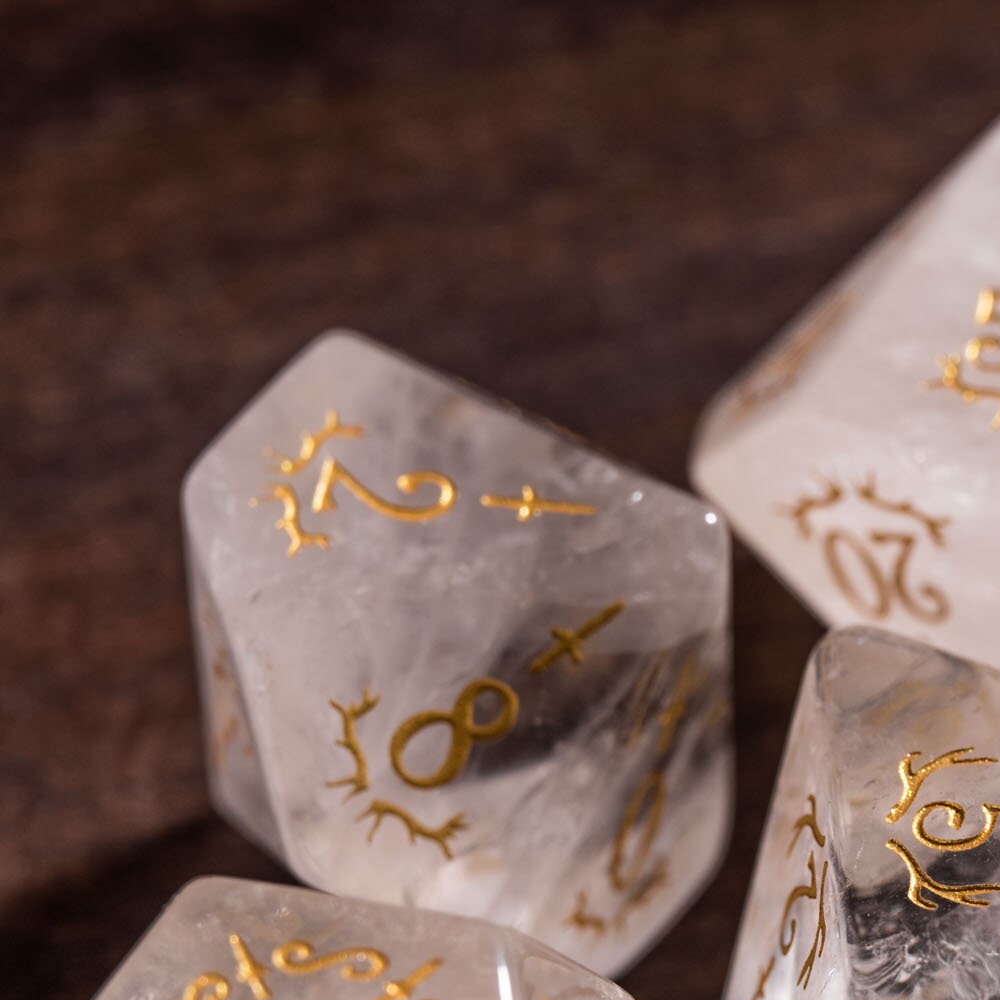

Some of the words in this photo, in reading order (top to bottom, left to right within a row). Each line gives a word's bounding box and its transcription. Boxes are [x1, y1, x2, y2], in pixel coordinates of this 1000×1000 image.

[312, 457, 459, 523] 2
[821, 529, 953, 626] 20
[389, 677, 520, 789] 8
